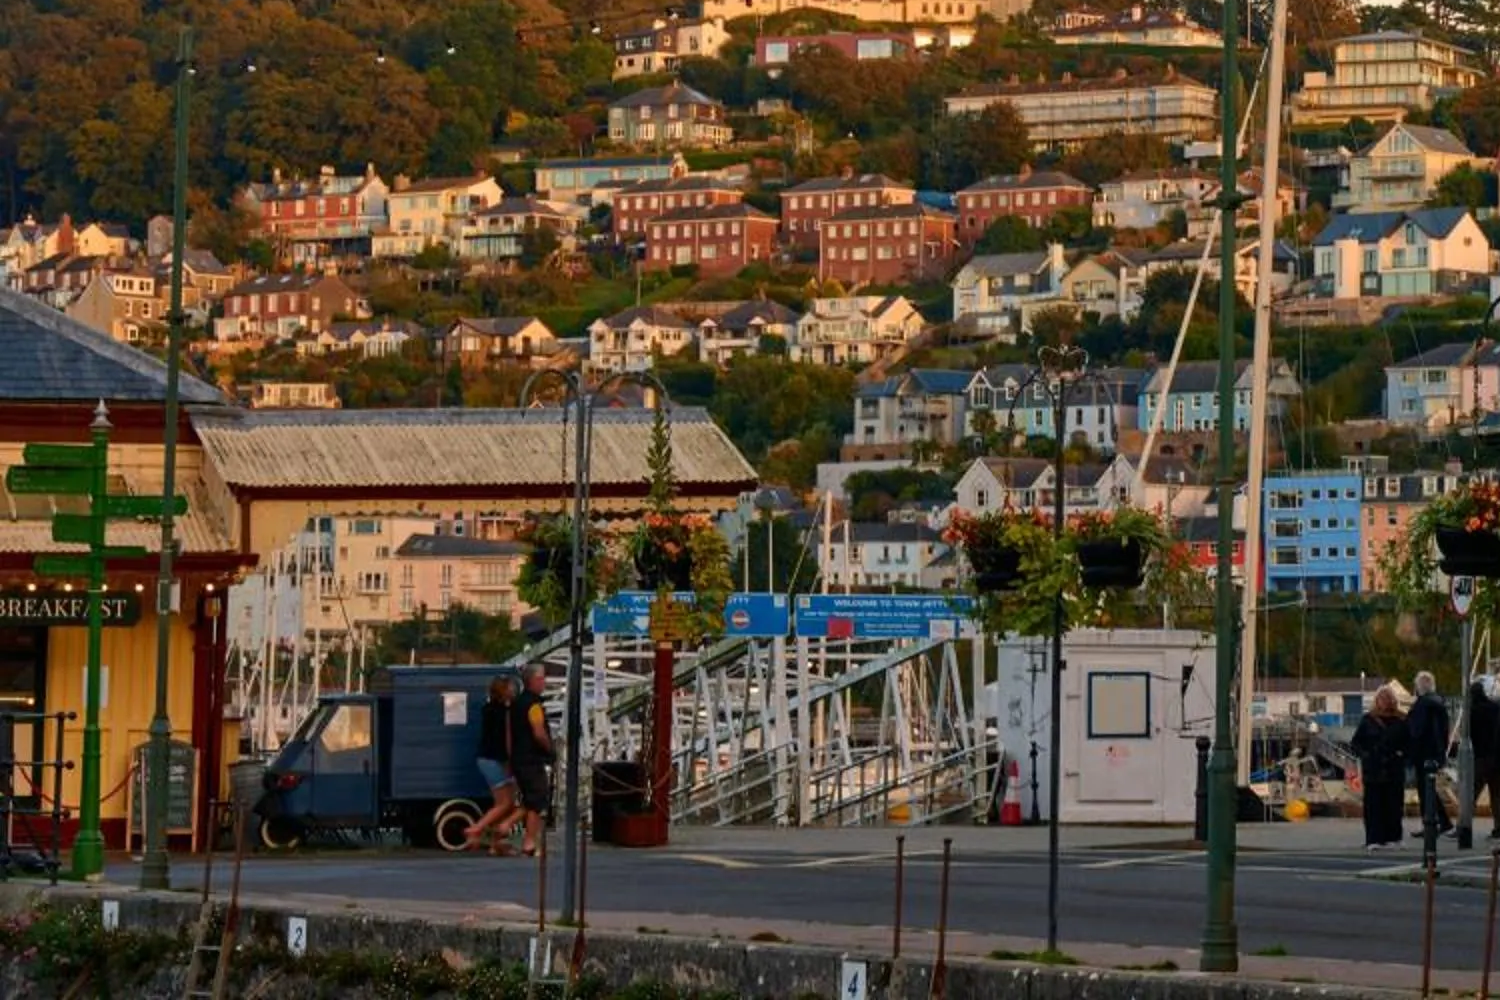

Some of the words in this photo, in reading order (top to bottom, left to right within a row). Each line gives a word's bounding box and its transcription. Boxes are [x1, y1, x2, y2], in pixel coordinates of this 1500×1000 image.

[833, 599, 877, 608] WELCOME
[294, 926, 303, 948] 2
[847, 971, 859, 999] 4
